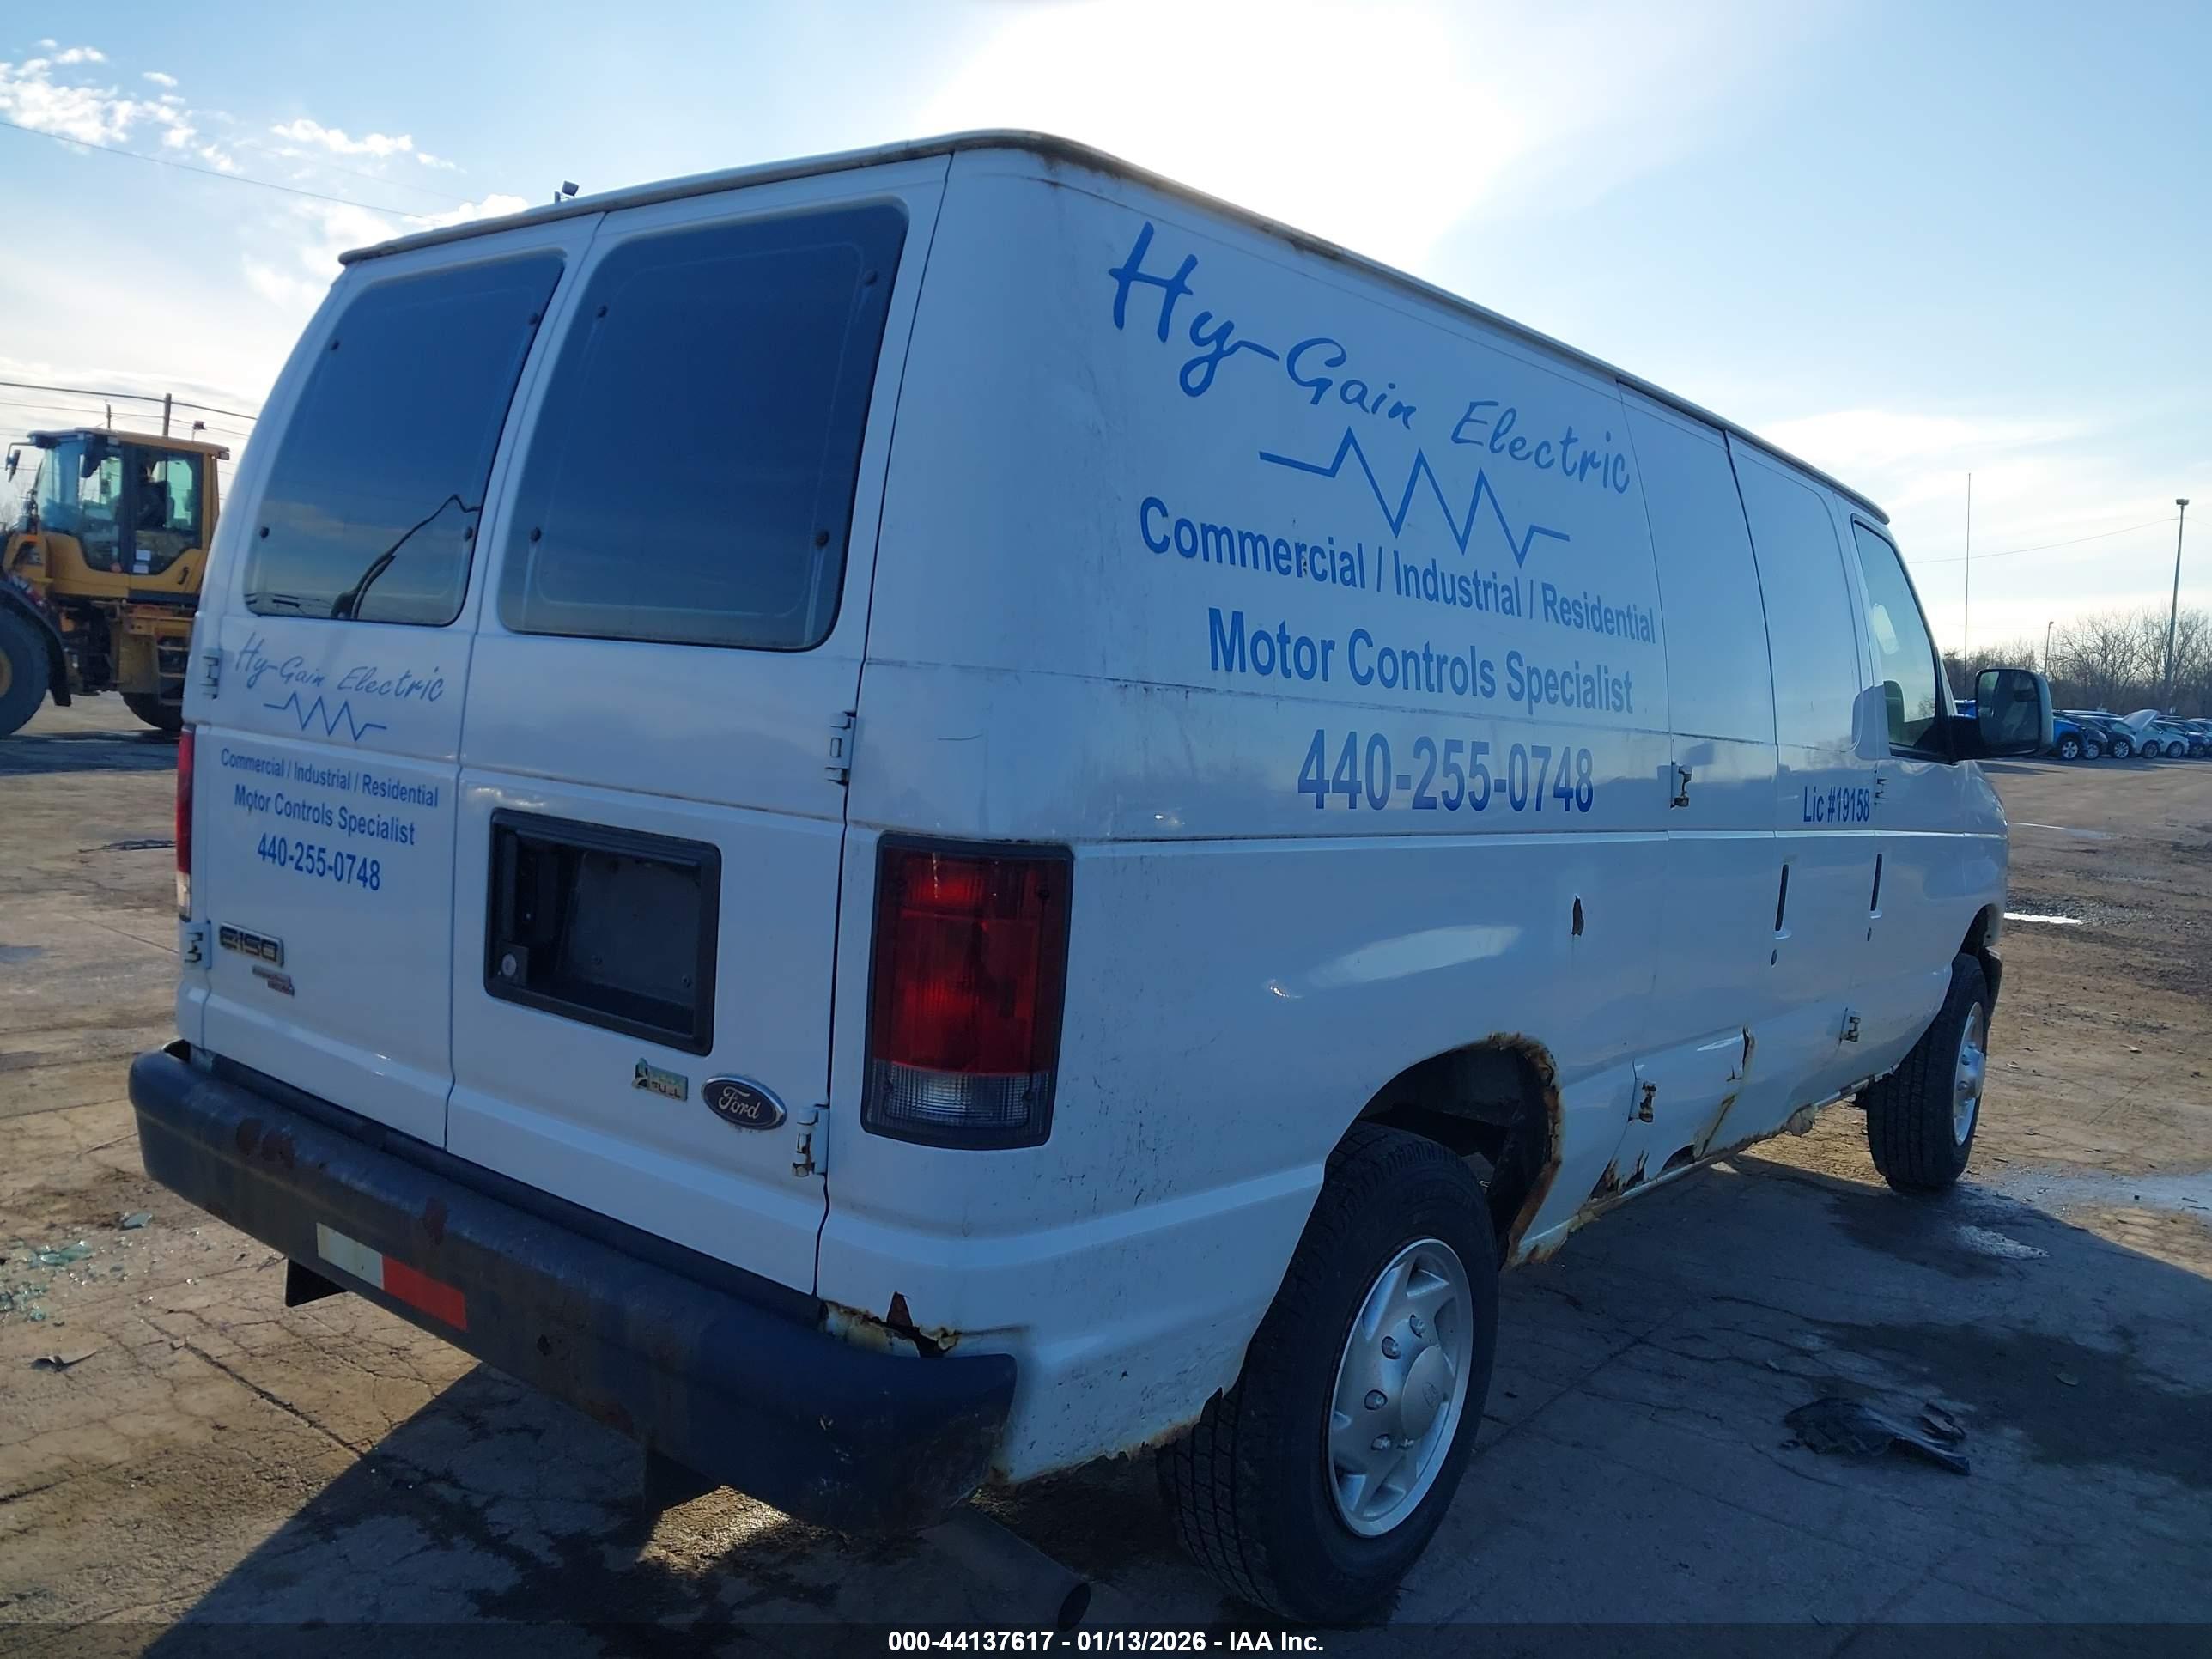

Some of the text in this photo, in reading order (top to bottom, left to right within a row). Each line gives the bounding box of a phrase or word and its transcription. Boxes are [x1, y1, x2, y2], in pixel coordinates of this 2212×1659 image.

[1109, 220, 1630, 494] Hy-Gain Electric
[1140, 496, 1365, 589] Commercial
[1394, 550, 1522, 618] Industrial
[1541, 582, 1656, 644] Residential
[234, 631, 444, 702] Hy-Gain Electric
[1208, 607, 1633, 714] Motor Controls Specialist
[221, 747, 285, 779] Commercial
[294, 761, 350, 791] Industrial
[362, 778, 439, 808] Residential
[1297, 728, 1595, 813] 440-255-0748
[234, 783, 415, 846] Motor Controls Specialist
[1803, 786, 1869, 823] Lic #19158
[258, 832, 381, 891] 440-255-0748
[718, 1085, 762, 1120] Ford
